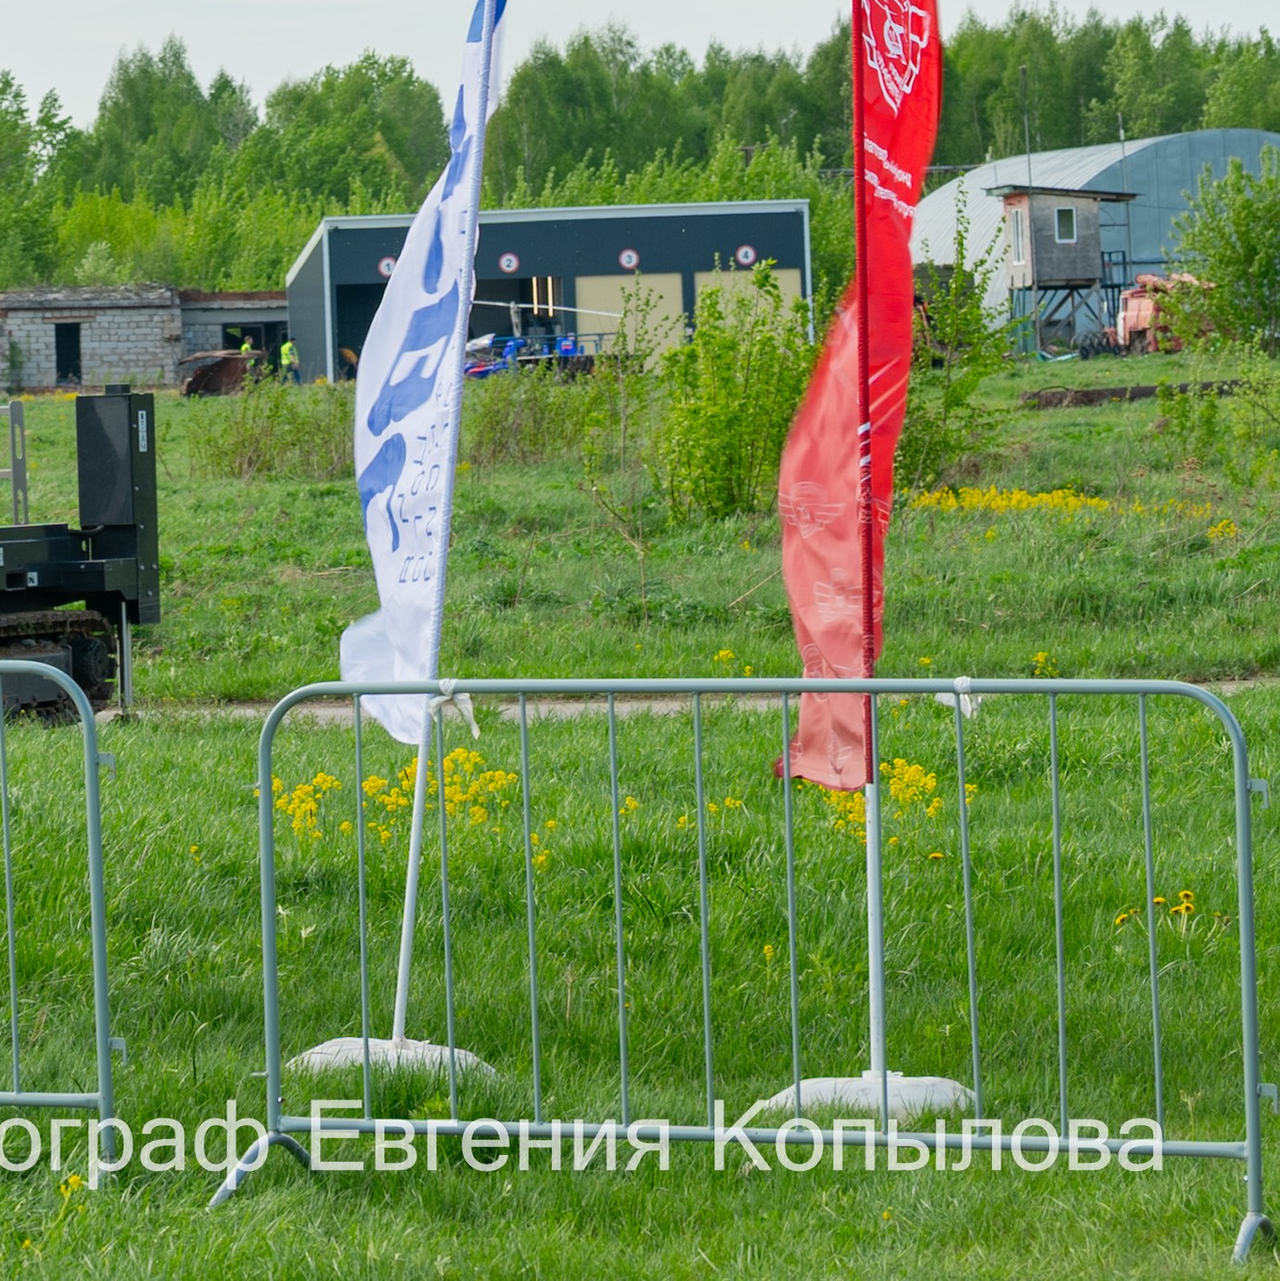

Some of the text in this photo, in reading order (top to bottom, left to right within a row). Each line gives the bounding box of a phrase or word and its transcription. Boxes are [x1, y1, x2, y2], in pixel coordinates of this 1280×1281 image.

[626, 254, 633, 265] 3
[742, 250, 750, 260] 4
[505, 258, 513, 269] 2
